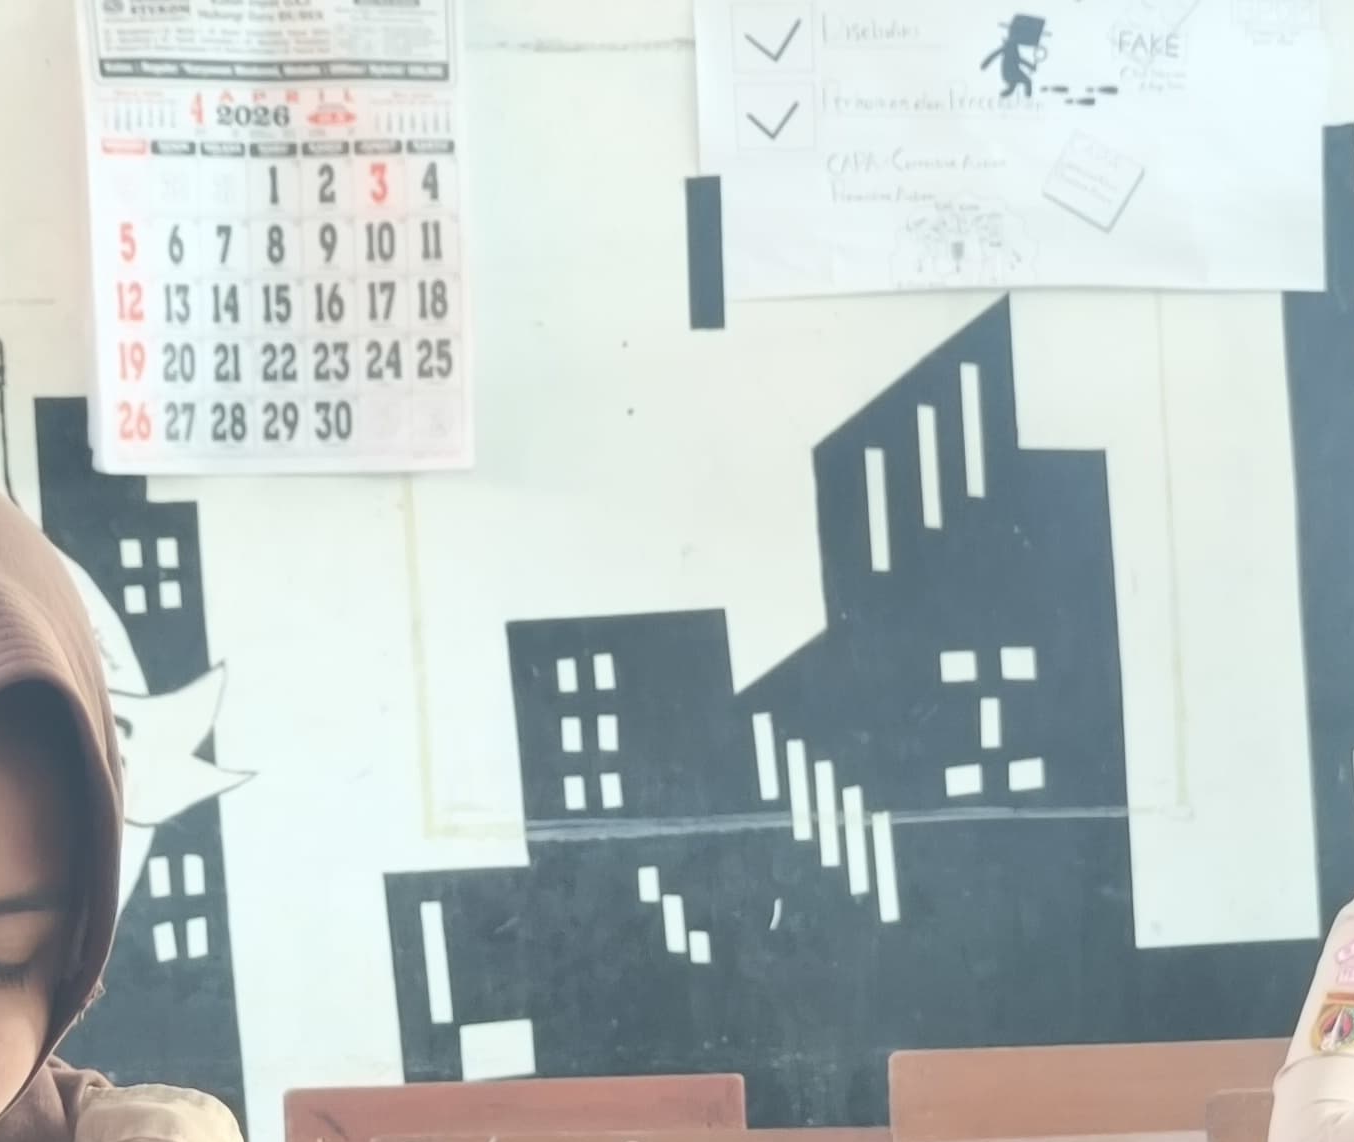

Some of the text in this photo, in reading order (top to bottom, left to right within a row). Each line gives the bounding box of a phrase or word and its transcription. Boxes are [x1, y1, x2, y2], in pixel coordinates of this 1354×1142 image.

[1116, 30, 1180, 60] FAKE
[191, 93, 203, 124] 4
[217, 106, 290, 127] 2026
[268, 161, 440, 206] 1 2 3 4
[120, 220, 443, 266] 5 6 7 8 9 10 11
[116, 278, 449, 325] 12 13 14 15 16 17 18
[119, 338, 453, 383] 19 20 21 22 23 24 25
[118, 399, 353, 443] 26 27 28 29 30
